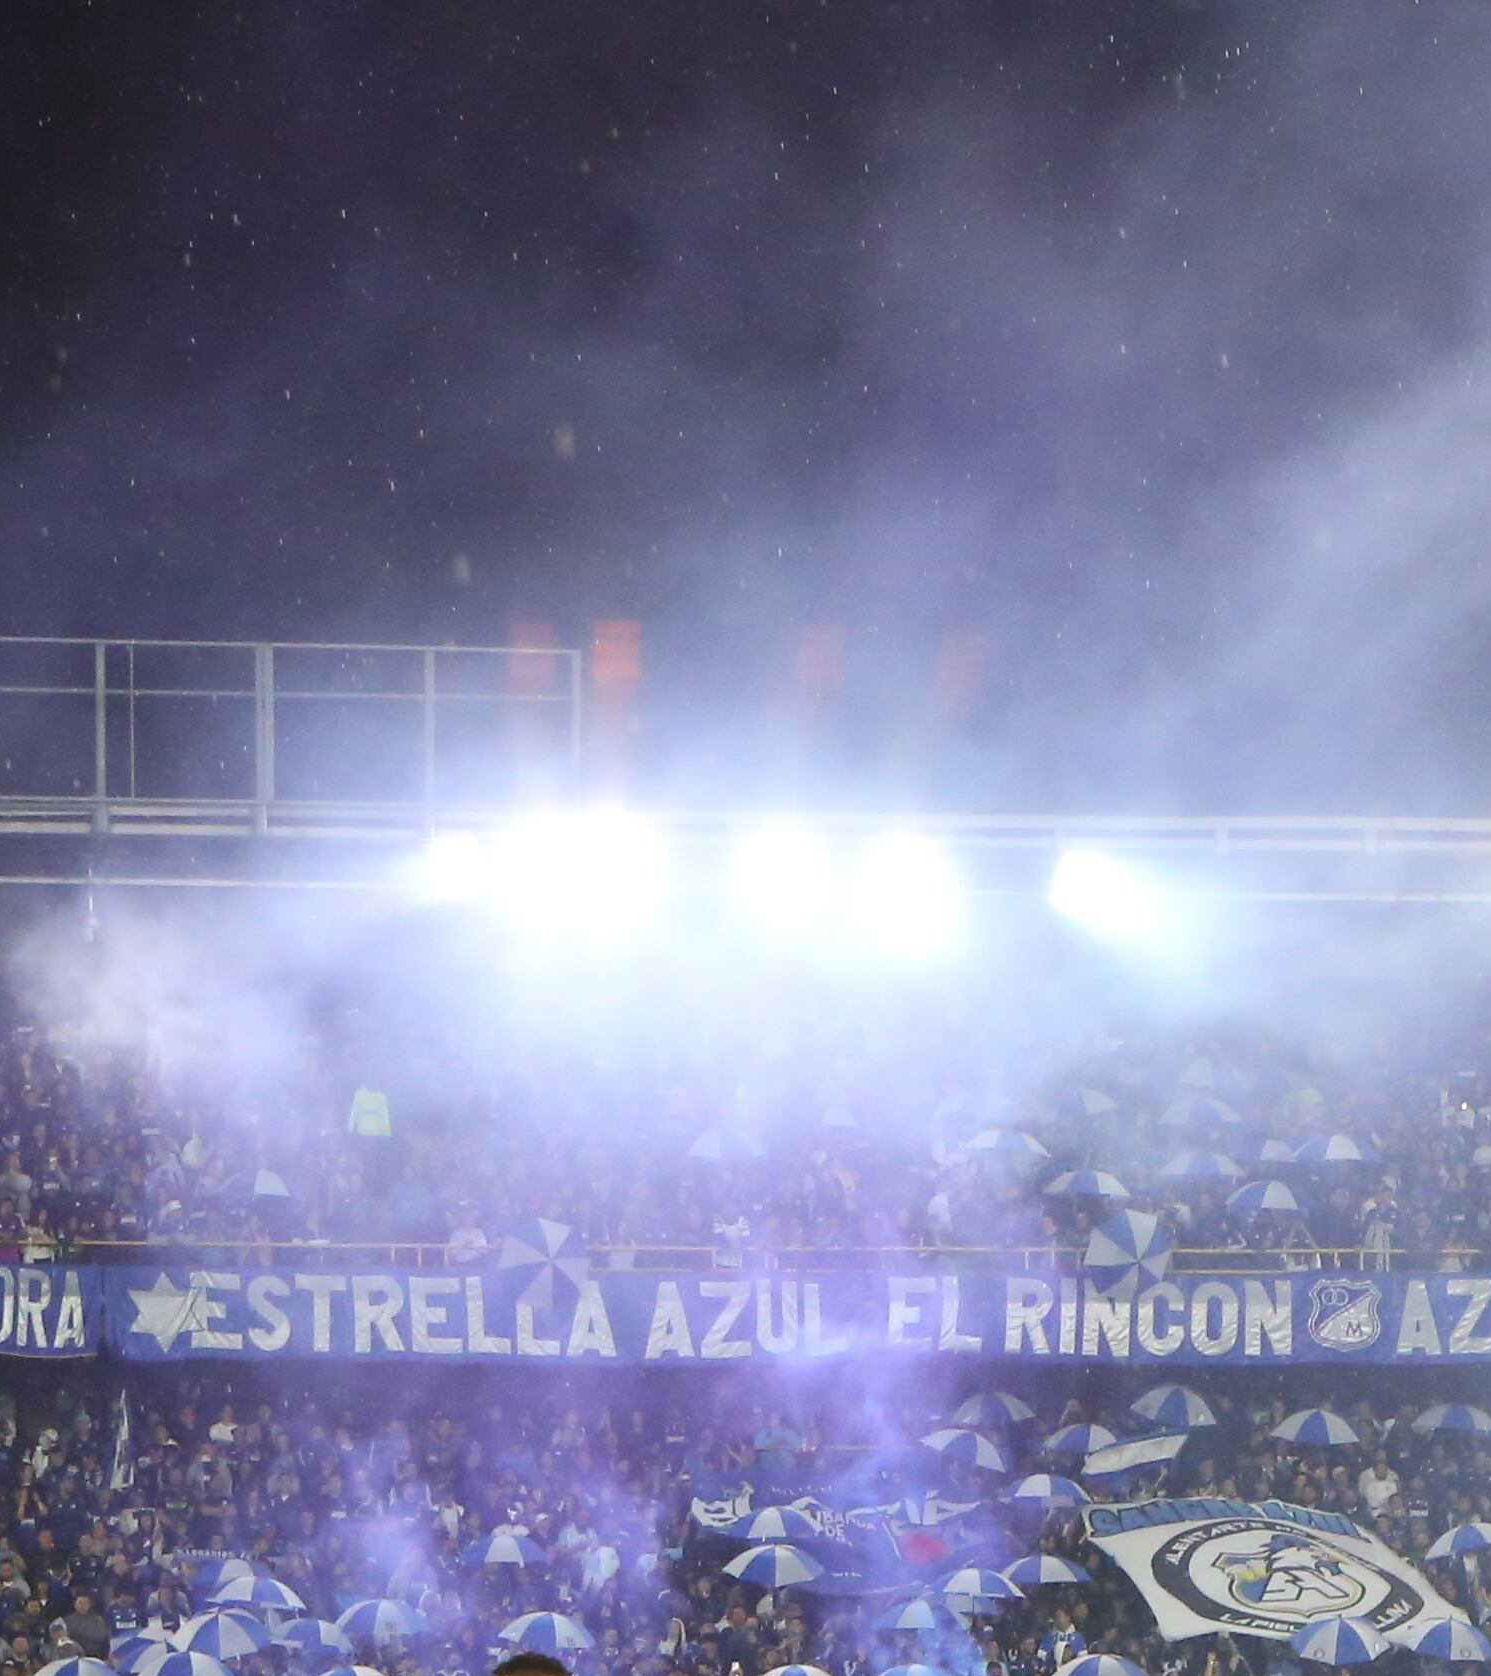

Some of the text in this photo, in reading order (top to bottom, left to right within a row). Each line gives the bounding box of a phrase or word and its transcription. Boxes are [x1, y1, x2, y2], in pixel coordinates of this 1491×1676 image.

[190, 1272, 1293, 1360] ESTRELLA AZUL EL RINCON
